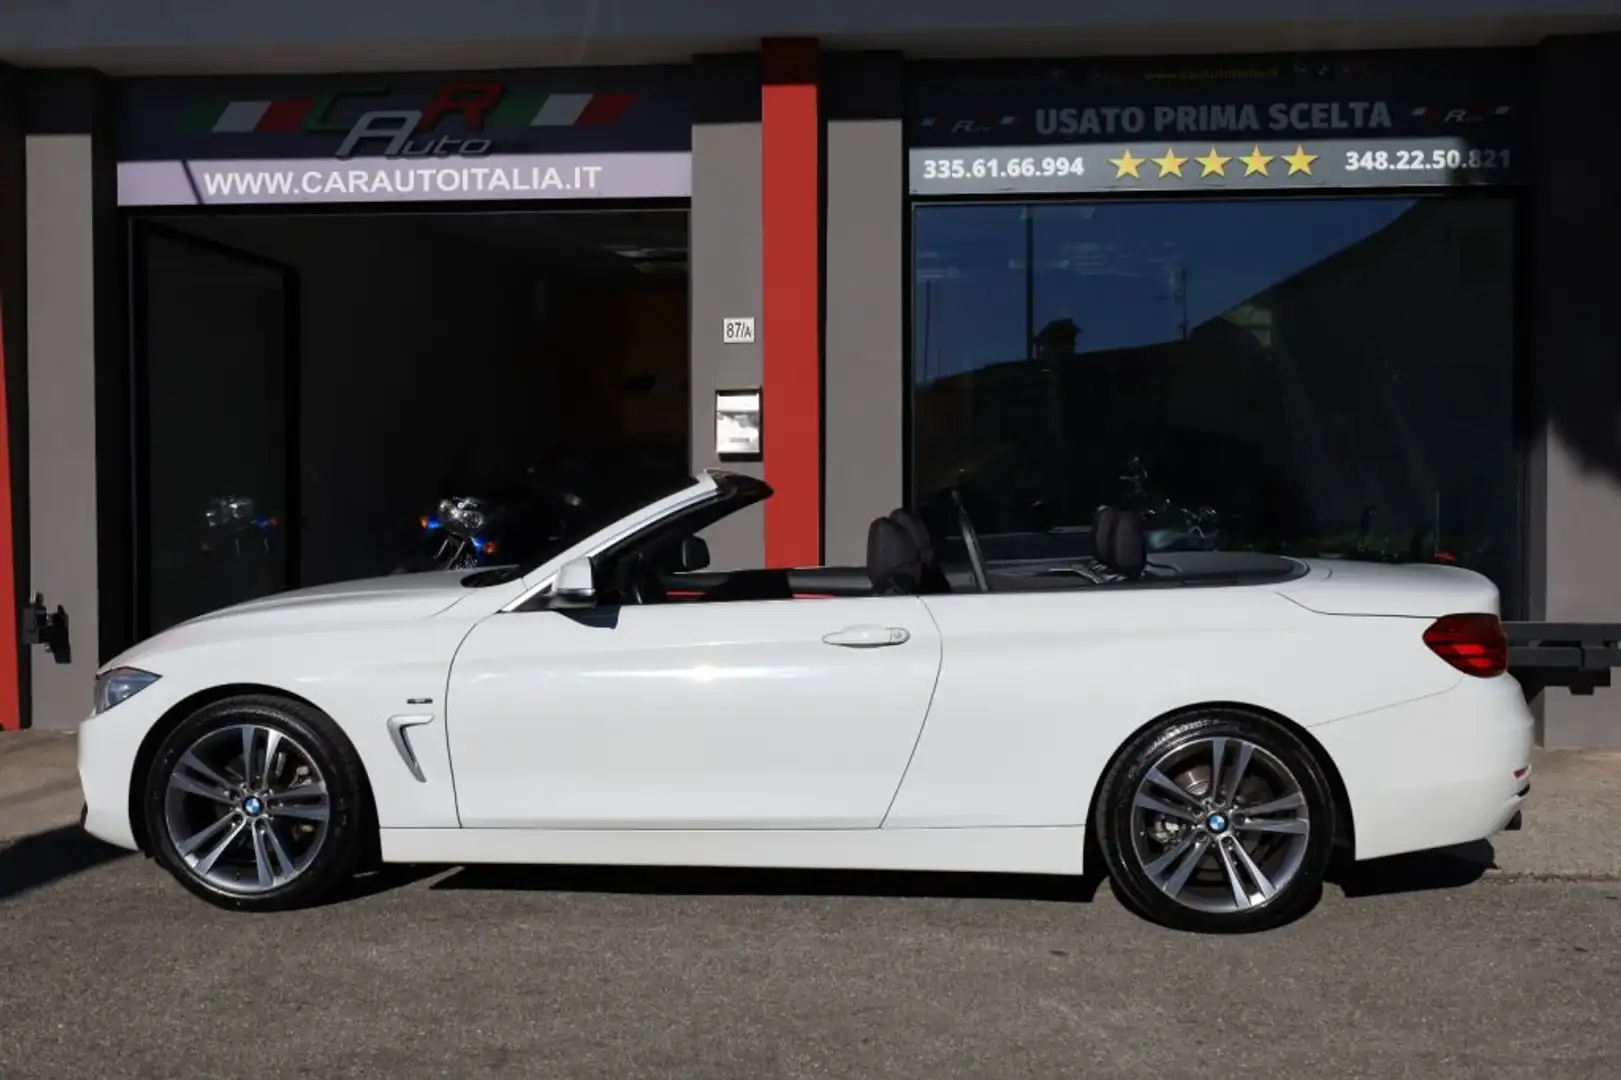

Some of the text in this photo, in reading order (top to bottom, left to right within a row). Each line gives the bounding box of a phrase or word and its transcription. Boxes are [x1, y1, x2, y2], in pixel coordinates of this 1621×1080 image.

[1035, 101, 1392, 135] USATO PRIMA SCELTA
[923, 157, 1085, 179] 335.61.66.994
[1345, 149, 1511, 171] 348.22.50.821
[203, 165, 603, 196] WWW.CARAUTOITALIA.IT
[726, 322, 752, 338] 87/A
